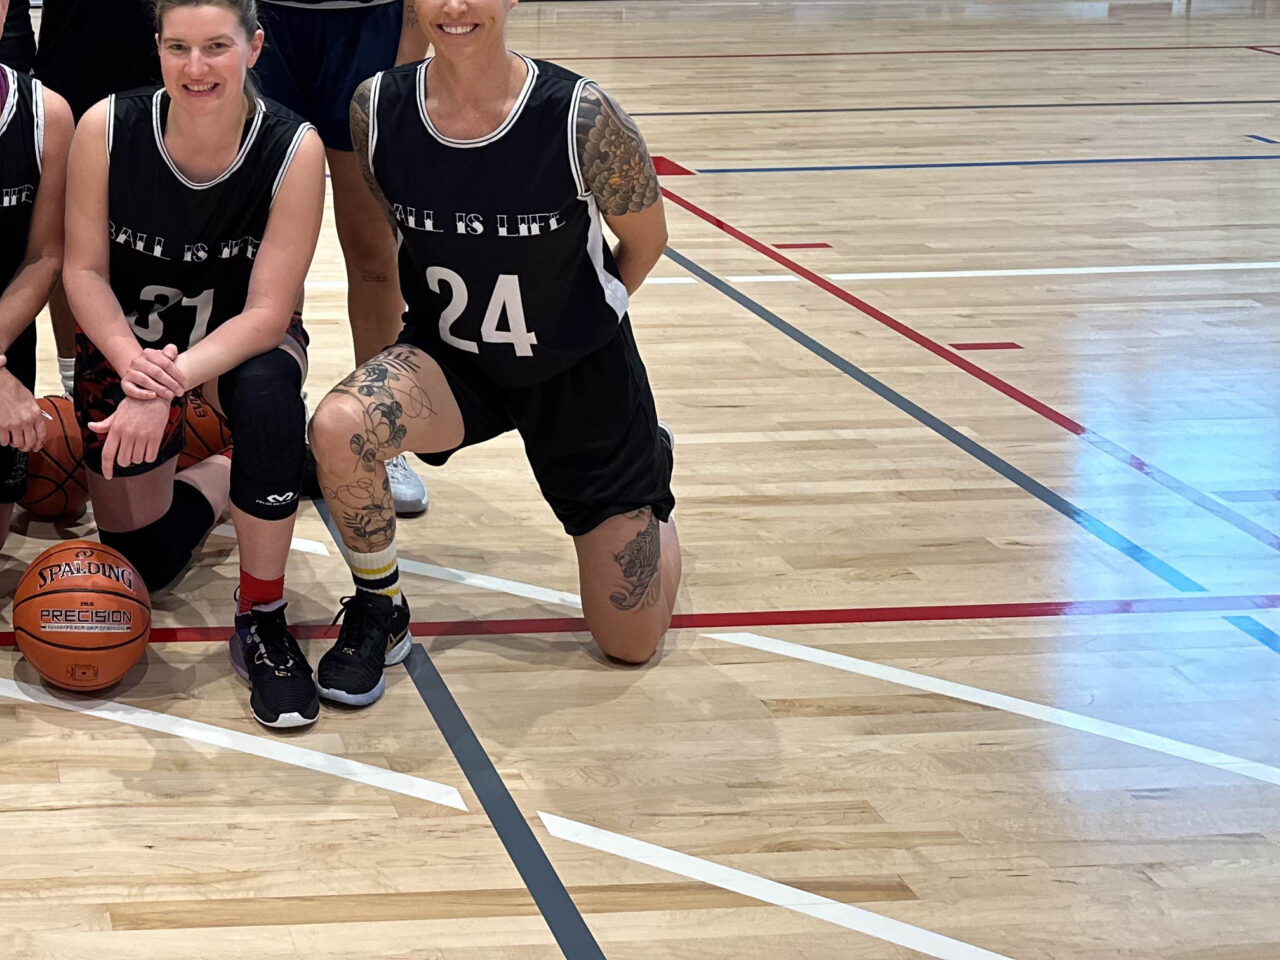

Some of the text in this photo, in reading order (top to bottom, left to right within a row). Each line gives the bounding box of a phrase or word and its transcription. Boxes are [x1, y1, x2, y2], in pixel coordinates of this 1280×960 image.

[455, 212, 484, 235] IS
[496, 210, 566, 237] LIFE
[183, 242, 209, 262] IS
[426, 266, 538, 357] 24
[37, 560, 133, 590] SPALDING
[40, 609, 132, 623] PRECISION
